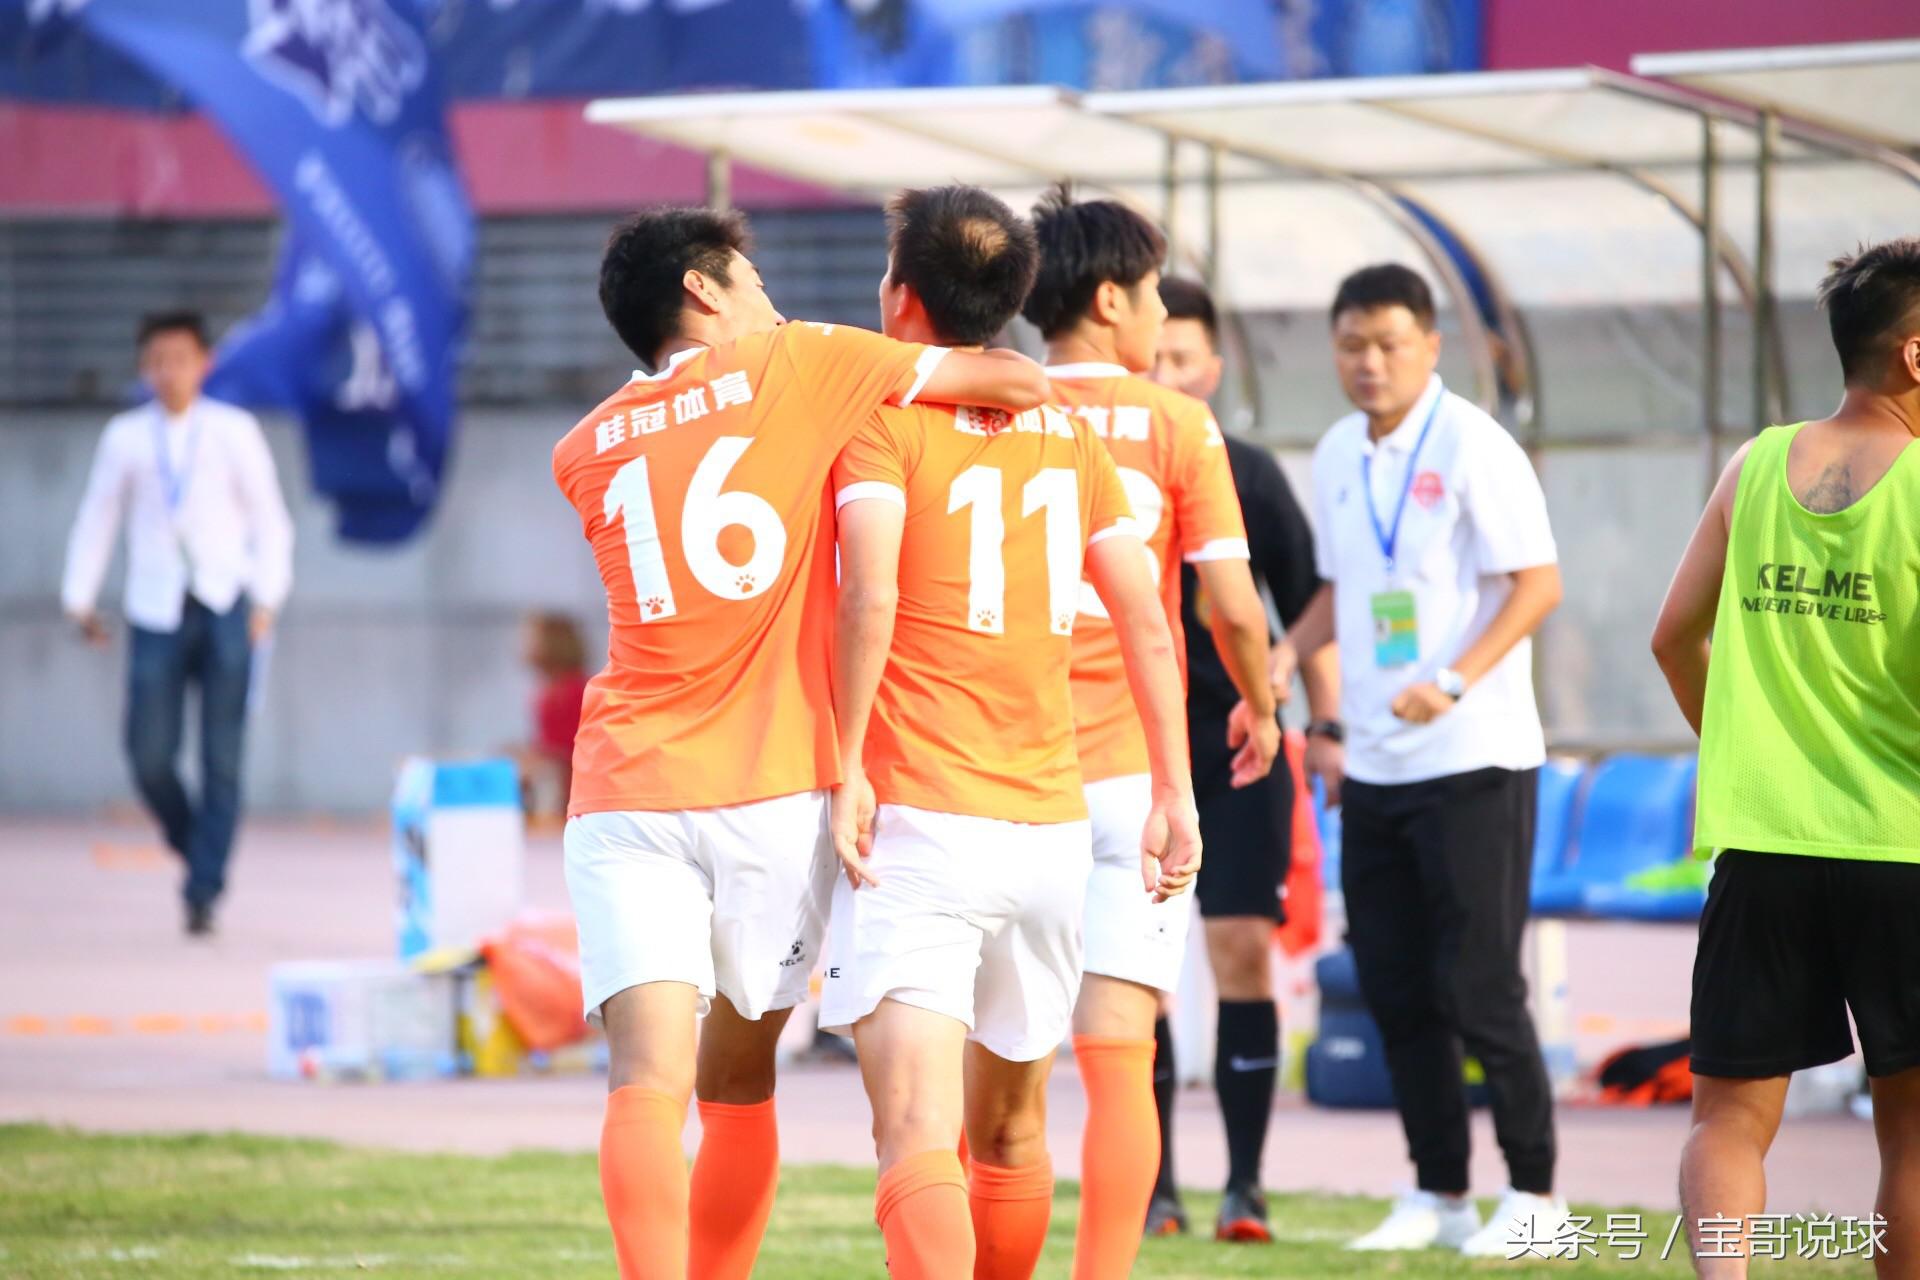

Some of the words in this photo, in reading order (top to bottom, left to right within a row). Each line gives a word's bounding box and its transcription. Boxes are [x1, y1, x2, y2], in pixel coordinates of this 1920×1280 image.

[595, 370, 754, 455] 桂冠体育
[603, 436, 787, 622] 16
[947, 465, 1081, 635] 11
[1757, 563, 1873, 601] KELME
[1795, 600, 1843, 620] GIVE
